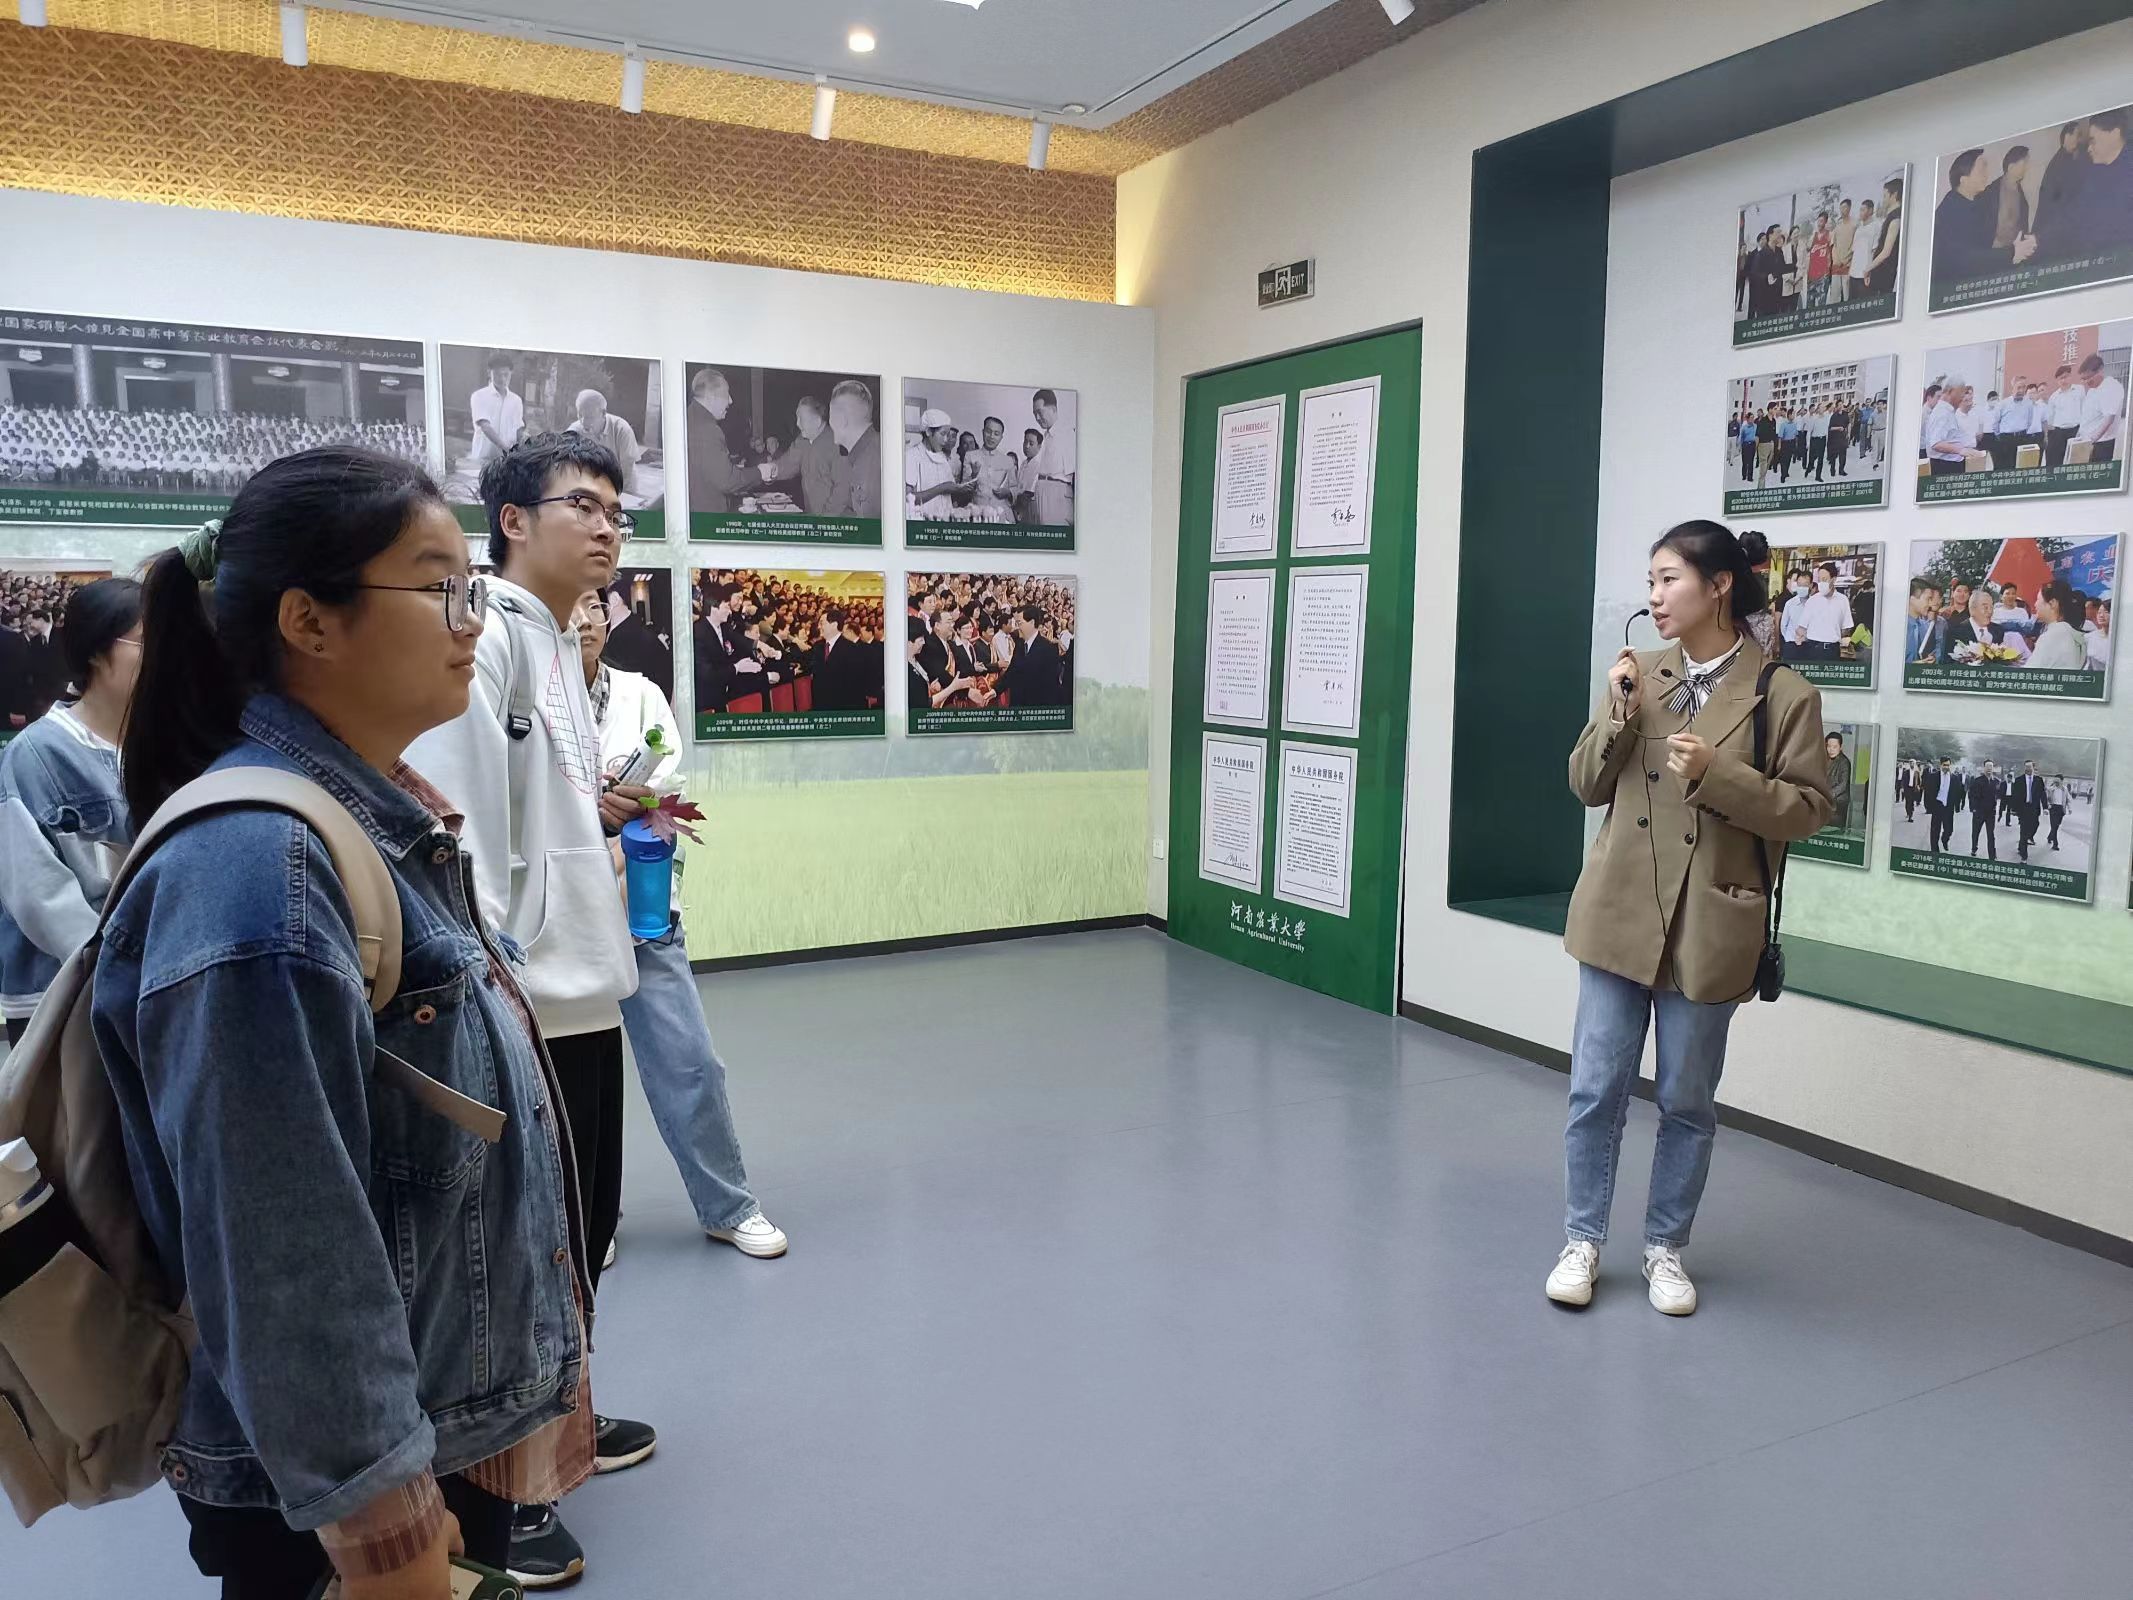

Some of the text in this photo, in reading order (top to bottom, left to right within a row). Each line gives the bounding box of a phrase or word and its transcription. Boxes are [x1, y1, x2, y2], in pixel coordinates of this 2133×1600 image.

[1291, 273, 1305, 288] EXIT
[1230, 921, 1305, 954] Henan Agricultural University
